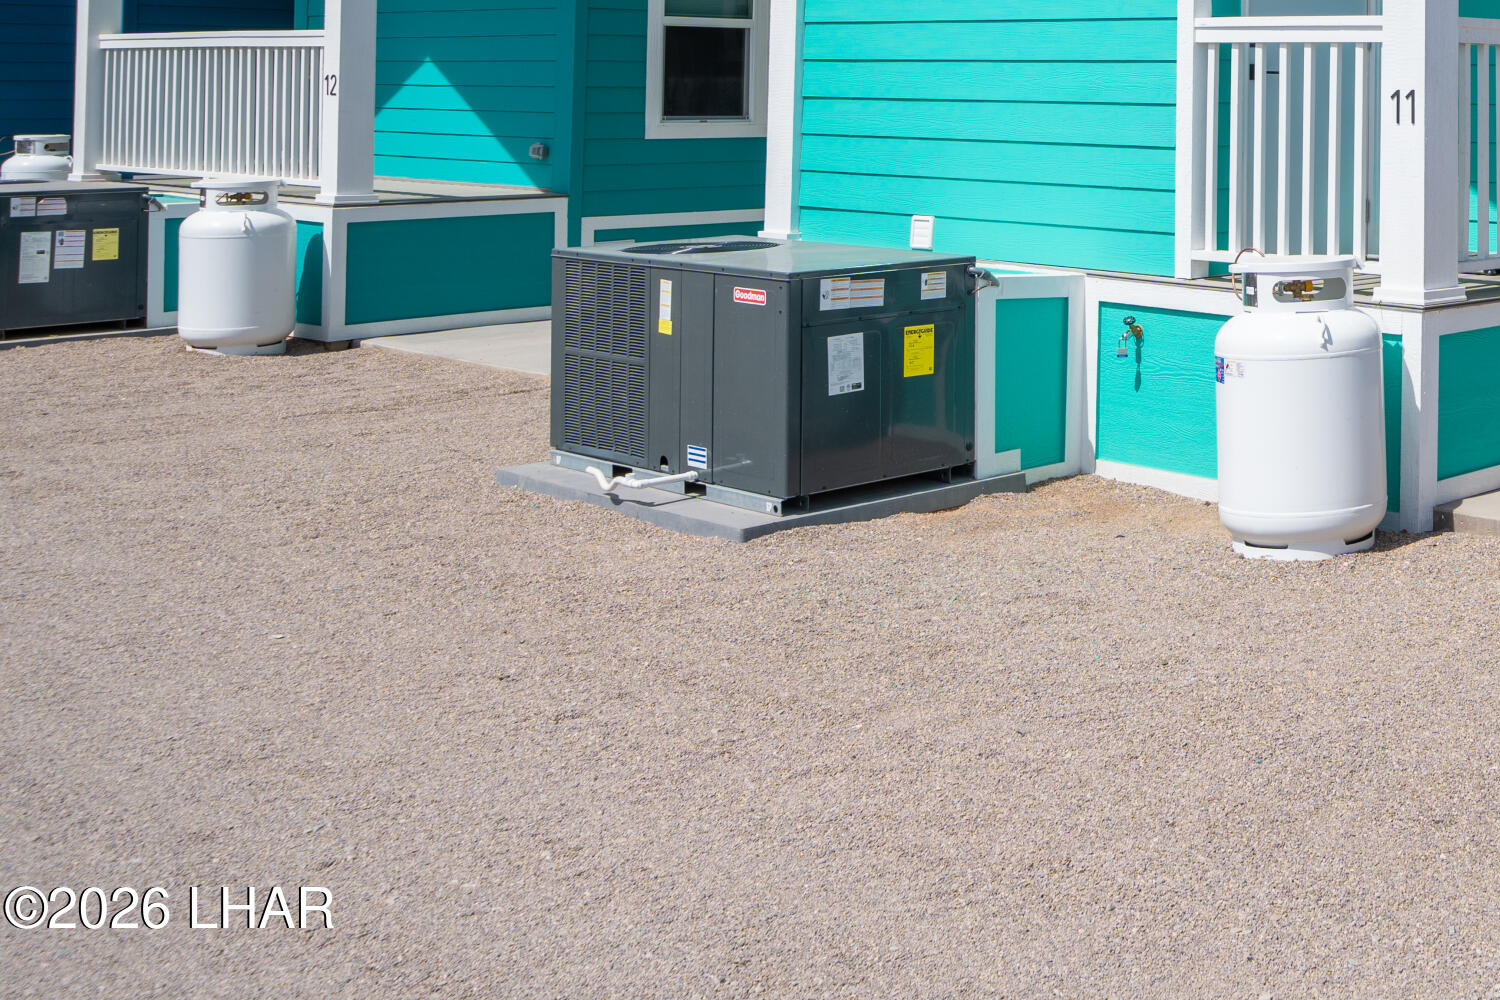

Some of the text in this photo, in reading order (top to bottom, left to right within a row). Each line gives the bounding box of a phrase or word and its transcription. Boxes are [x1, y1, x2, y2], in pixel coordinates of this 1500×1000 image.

[325, 74, 337, 96] 12
[1390, 89, 1416, 125] 11
[735, 289, 765, 302] Goodman
